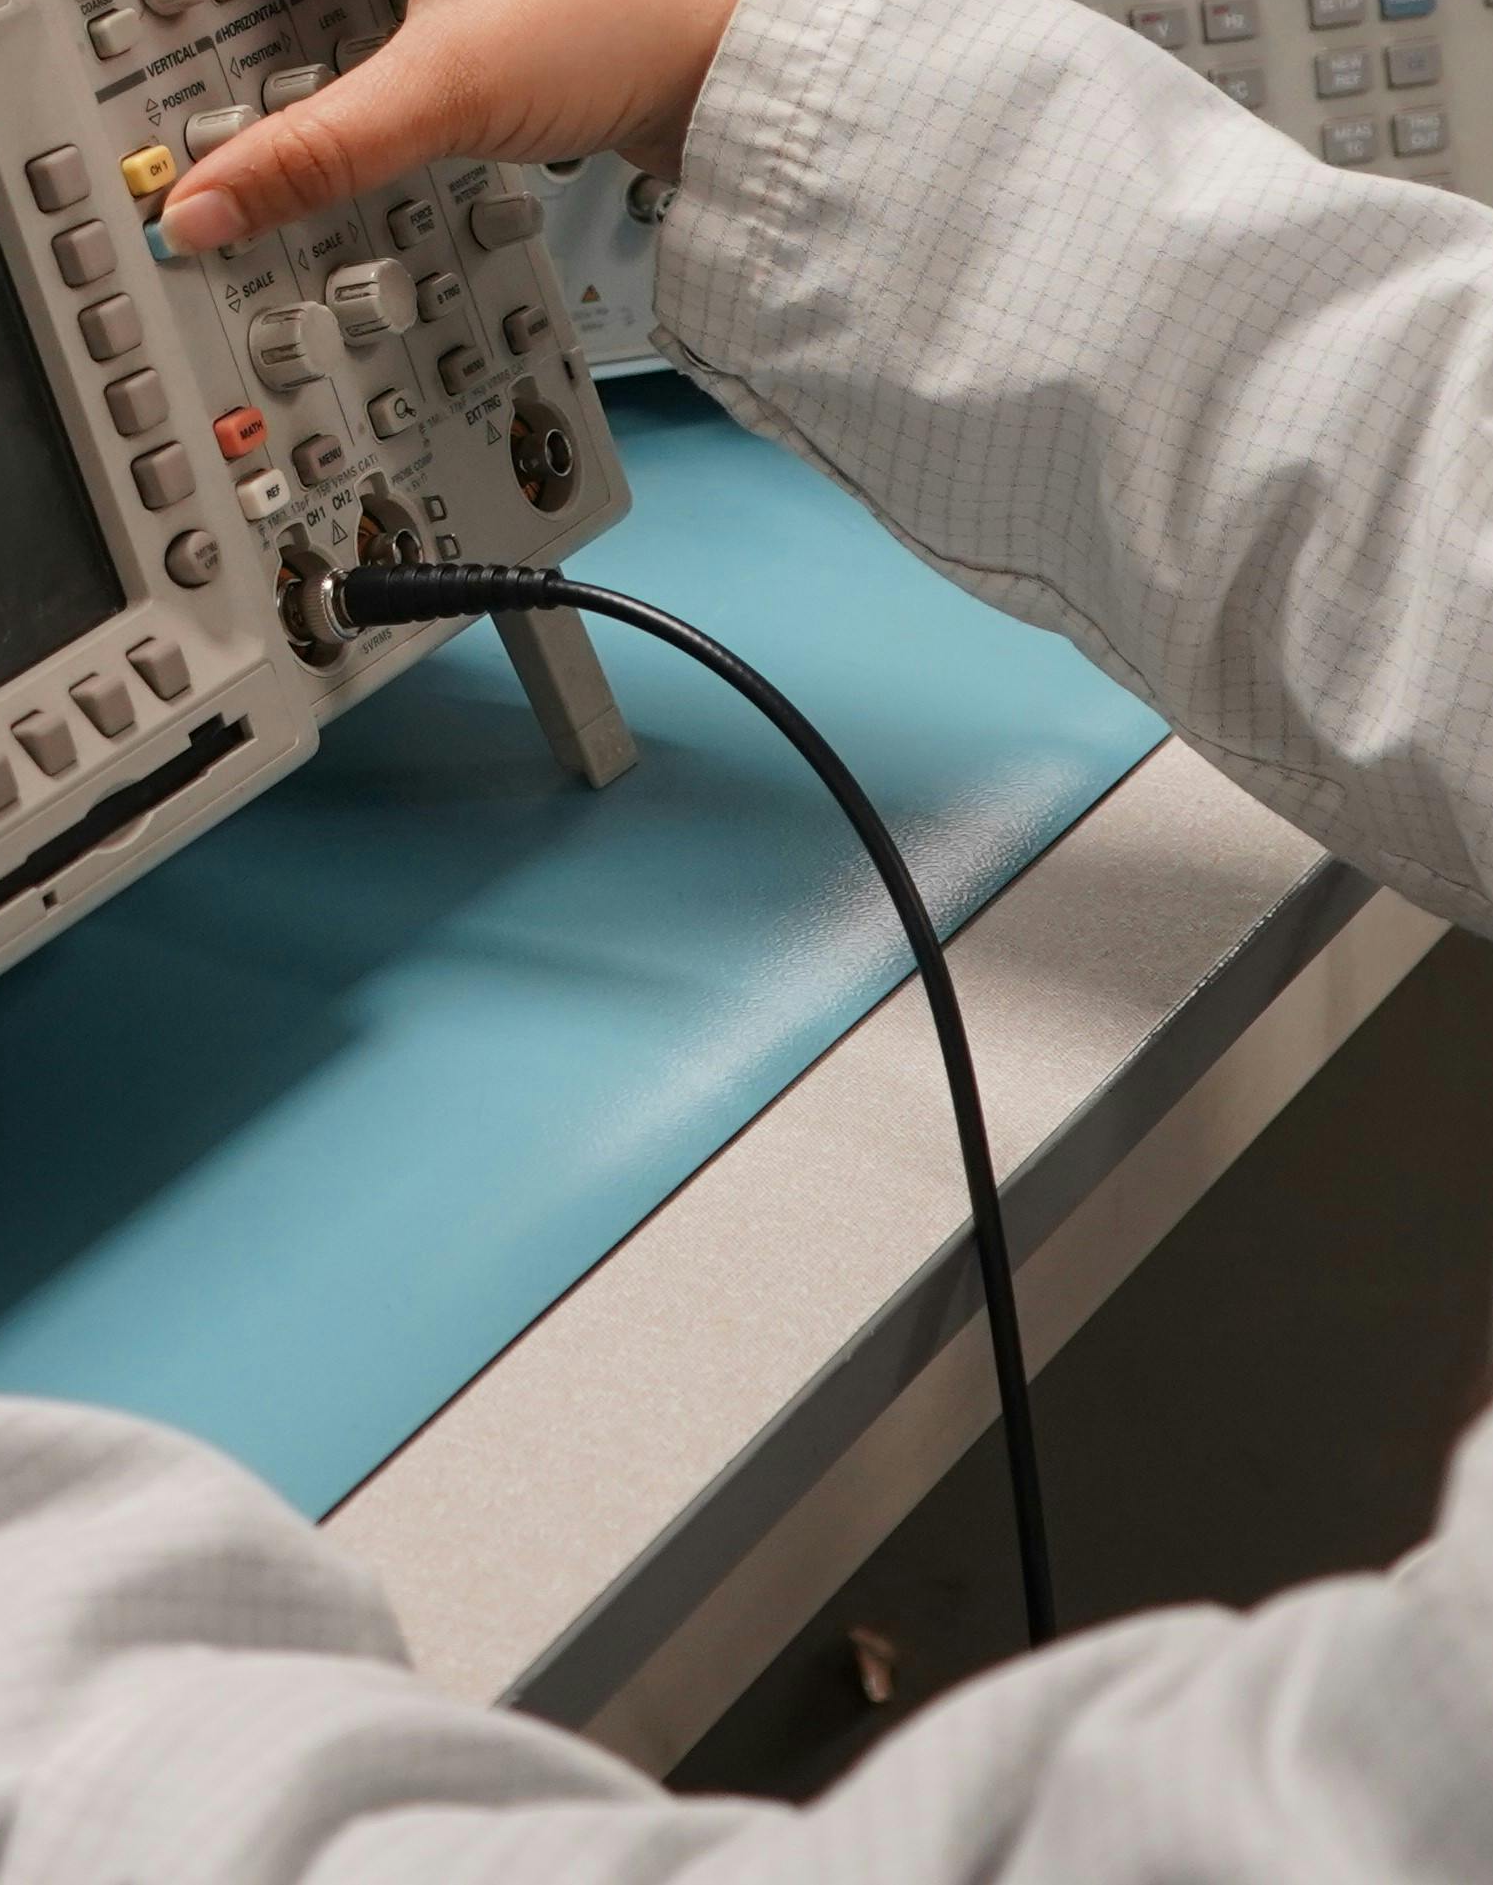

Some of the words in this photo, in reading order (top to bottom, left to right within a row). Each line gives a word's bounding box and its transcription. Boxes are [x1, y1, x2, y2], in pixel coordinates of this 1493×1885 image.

[219, 1, 283, 42] HORIZONTAL
[317, 6, 348, 30] LEVEL
[146, 45, 198, 80] VERTICAL
[238, 41, 283, 73] POSITION
[161, 80, 207, 112] POSITION
[447, 164, 489, 193] WAVEFORM
[454, 179, 491, 206] INTENSITY
[311, 231, 345, 259] SCALE
[242, 271, 276, 300] SCALE
[462, 356, 486, 377] MENU
[465, 407, 483, 427] EXT
[482, 394, 503, 415] TRIG
[239, 419, 264, 441] MATH
[317, 447, 343, 469] MENU
[266, 482, 282, 500] REF
